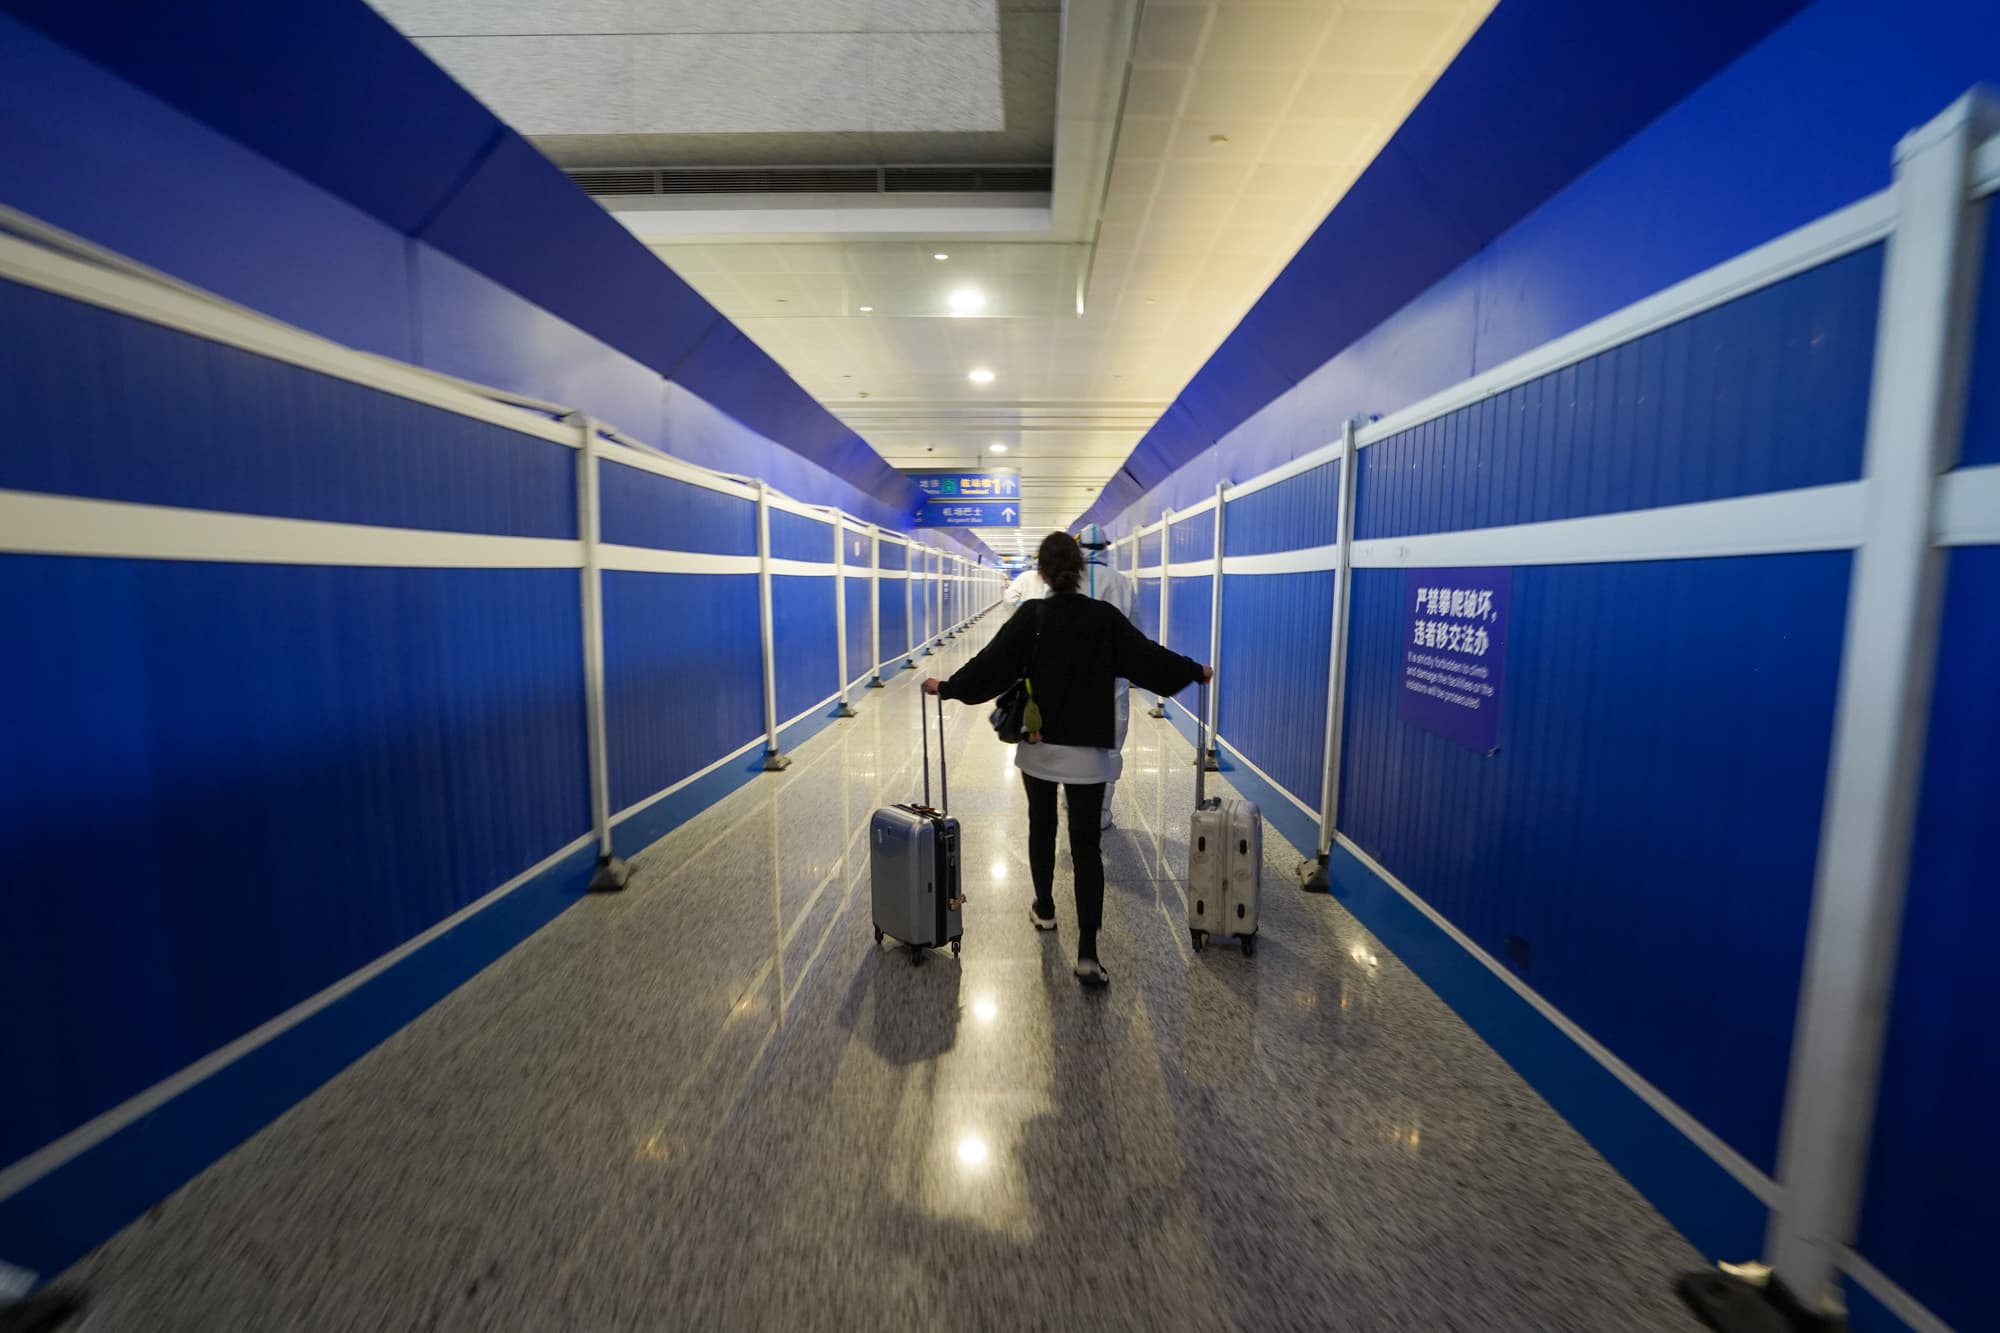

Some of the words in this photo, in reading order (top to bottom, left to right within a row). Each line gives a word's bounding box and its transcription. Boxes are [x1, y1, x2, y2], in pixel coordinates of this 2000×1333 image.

[992, 479, 1000, 494] 1
[942, 508, 982, 517] 机场巴士
[1414, 619, 1490, 656] 违者移交法办
[1416, 654, 1434, 668] strictly
[1434, 656, 1462, 672] forbidden
[1462, 663, 1470, 674] to
[1406, 666, 1417, 677] and
[1416, 668, 1437, 684] damage
[1437, 673, 1448, 684] the
[1447, 674, 1473, 692] facilities
[1406, 680, 1427, 694] violators
[1427, 686, 1436, 696] will
[1444, 690, 1480, 710] prosecuted
